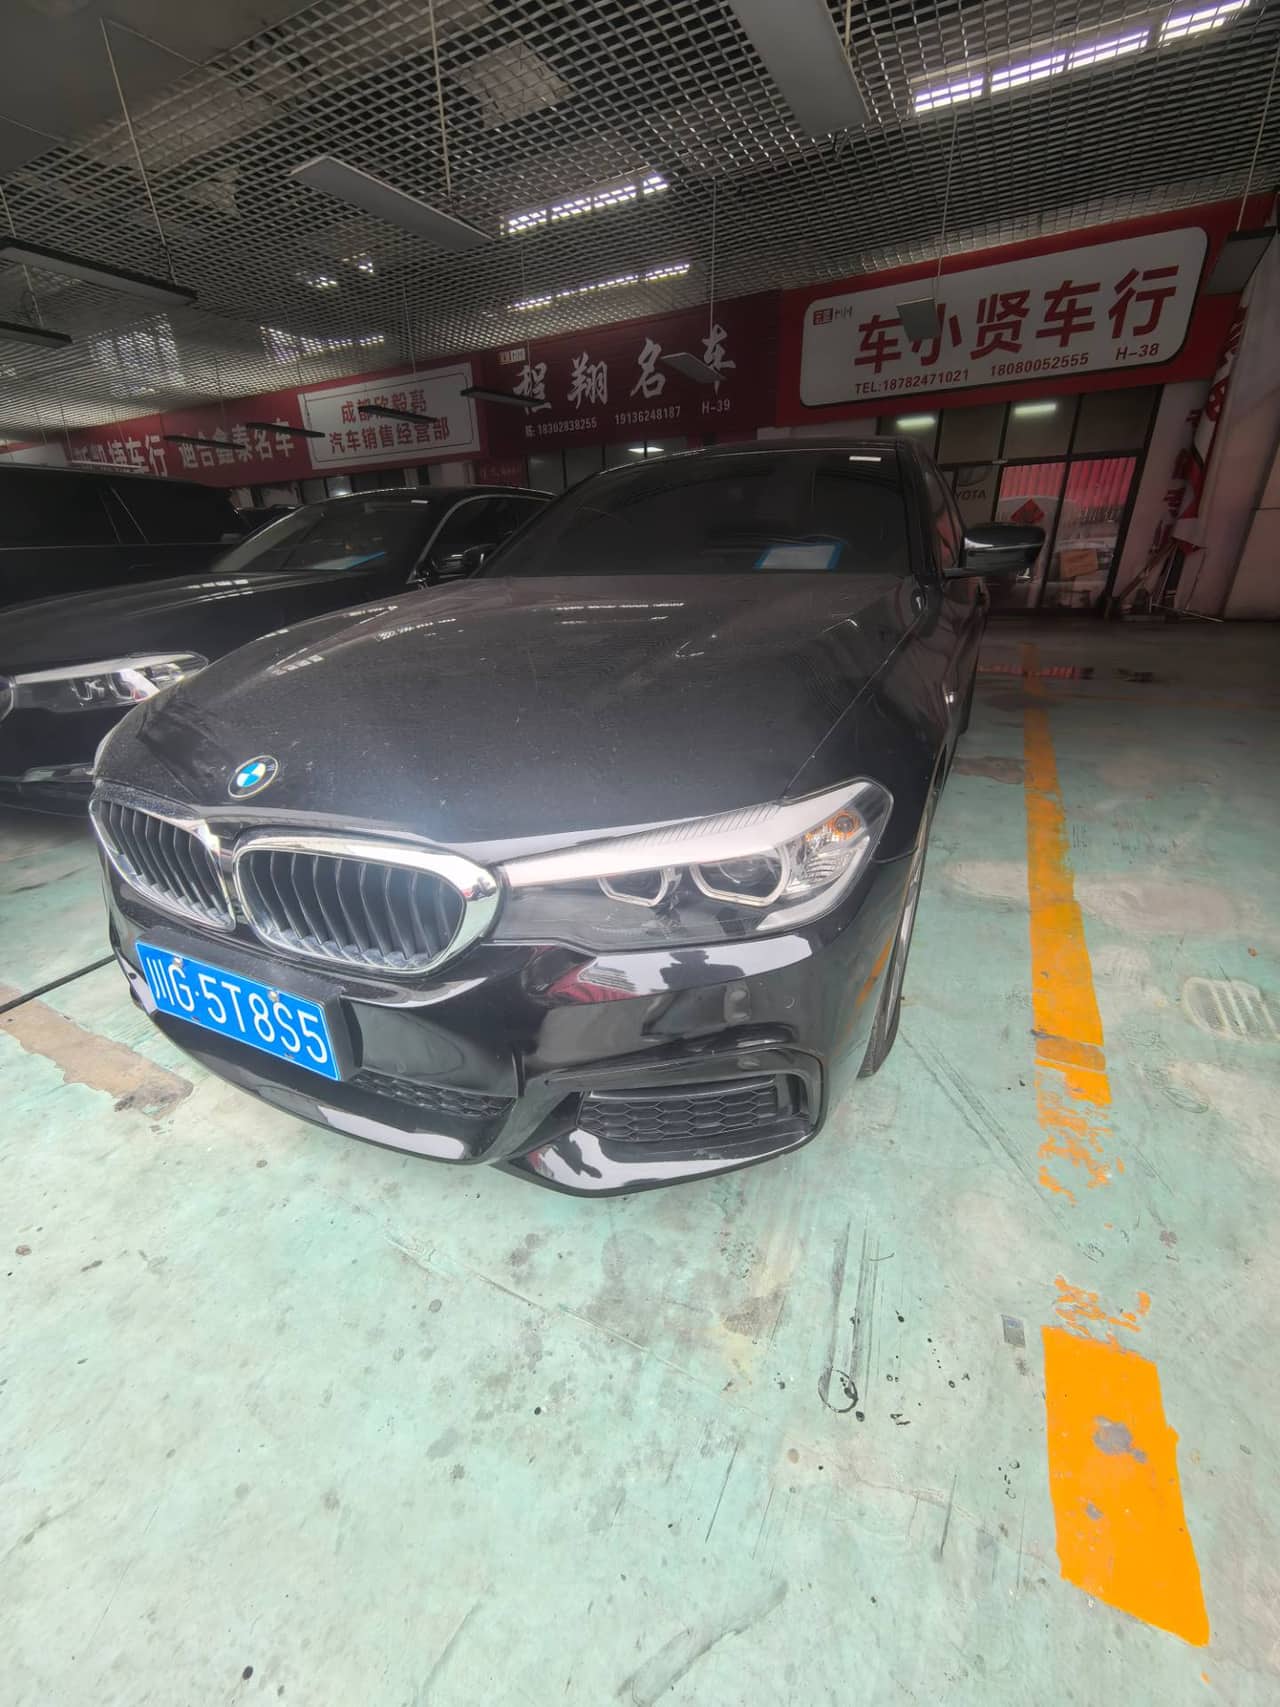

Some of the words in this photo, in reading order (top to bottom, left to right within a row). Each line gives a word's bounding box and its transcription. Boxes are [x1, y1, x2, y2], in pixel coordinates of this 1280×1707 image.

[854, 264, 1179, 374] 车小贤车行
[855, 369, 969, 395] TEL:18782471021
[990, 352, 1089, 376] 18080052555
[1116, 343, 1160, 361] H-38
[329, 416, 450, 453] 汽车销售经营部
[615, 406, 681, 425] 19136248187
[702, 400, 731, 415] H-39
